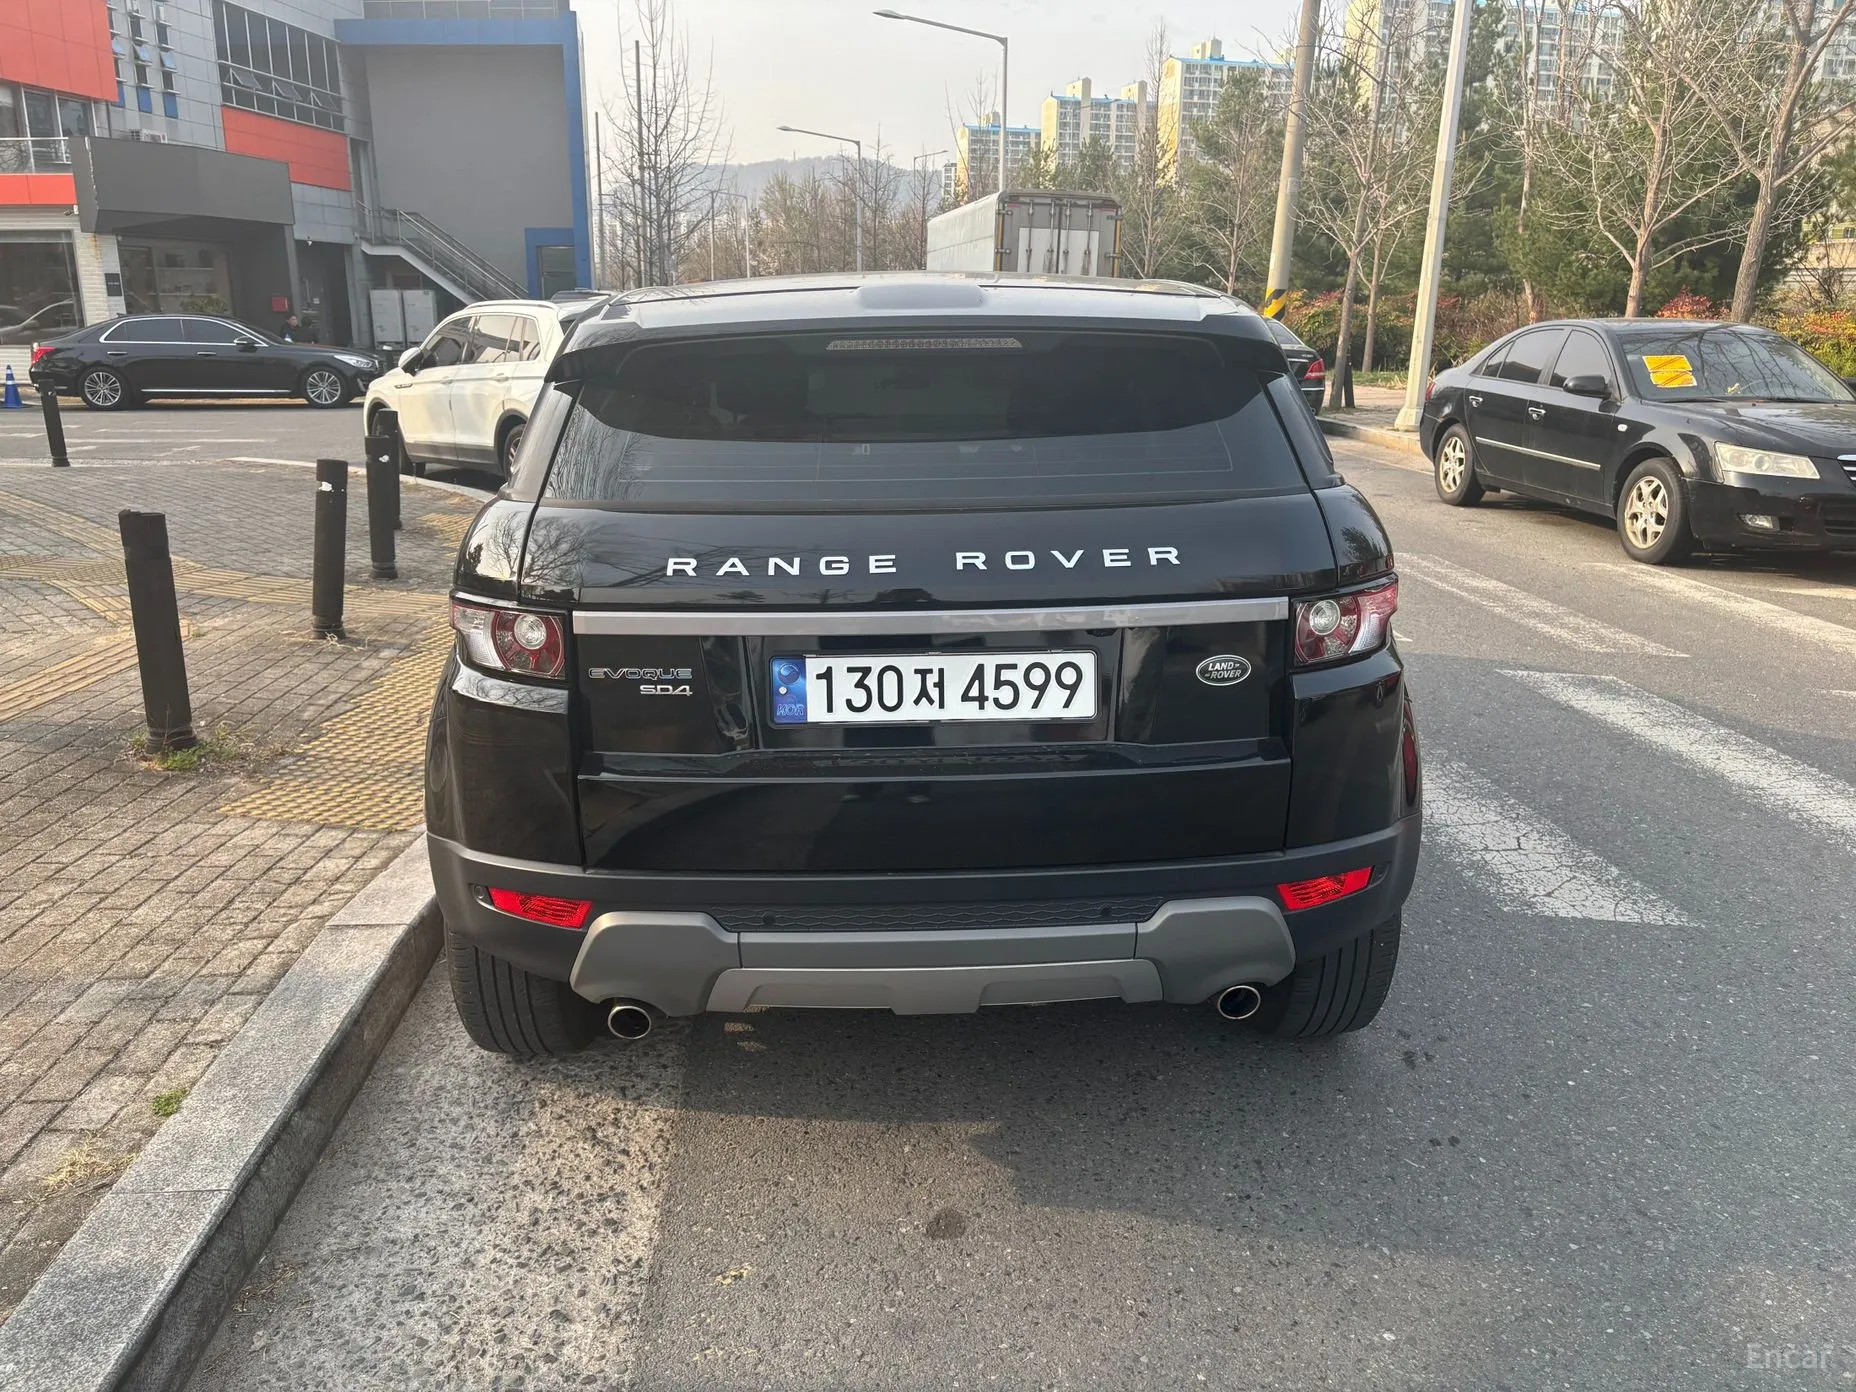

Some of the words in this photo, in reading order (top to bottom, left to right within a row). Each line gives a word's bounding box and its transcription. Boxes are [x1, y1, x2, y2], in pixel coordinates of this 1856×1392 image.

[666, 554, 897, 576] RANGE
[955, 546, 1181, 570] ROVER
[1208, 661, 1234, 671] LAND
[588, 667, 693, 681] EVOQUE
[1210, 669, 1242, 679] ROVER
[640, 685, 693, 697] SD4
[815, 664, 945, 713] 130저
[960, 661, 1084, 710] 4599
[776, 703, 805, 717] KOR
